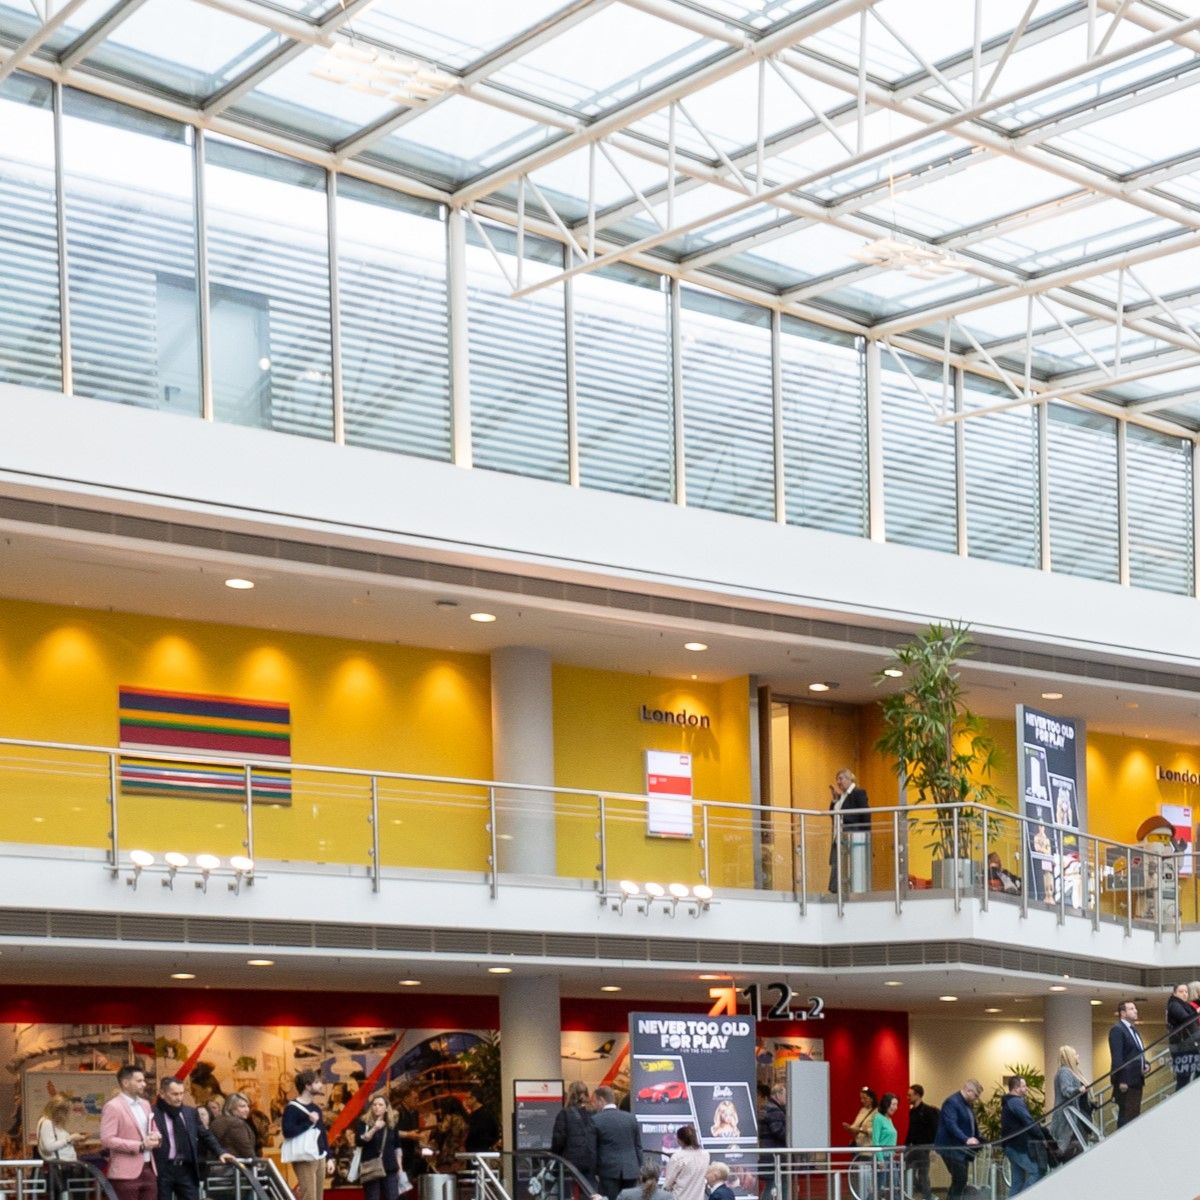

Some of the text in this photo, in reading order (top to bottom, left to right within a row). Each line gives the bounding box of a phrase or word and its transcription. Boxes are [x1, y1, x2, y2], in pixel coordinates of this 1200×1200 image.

[641, 704, 710, 728] London
[1061, 723, 1075, 740] OLD
[638, 1020, 750, 1037] NEVER TOO OLD
[661, 1035, 729, 1049] FOR PLAY
